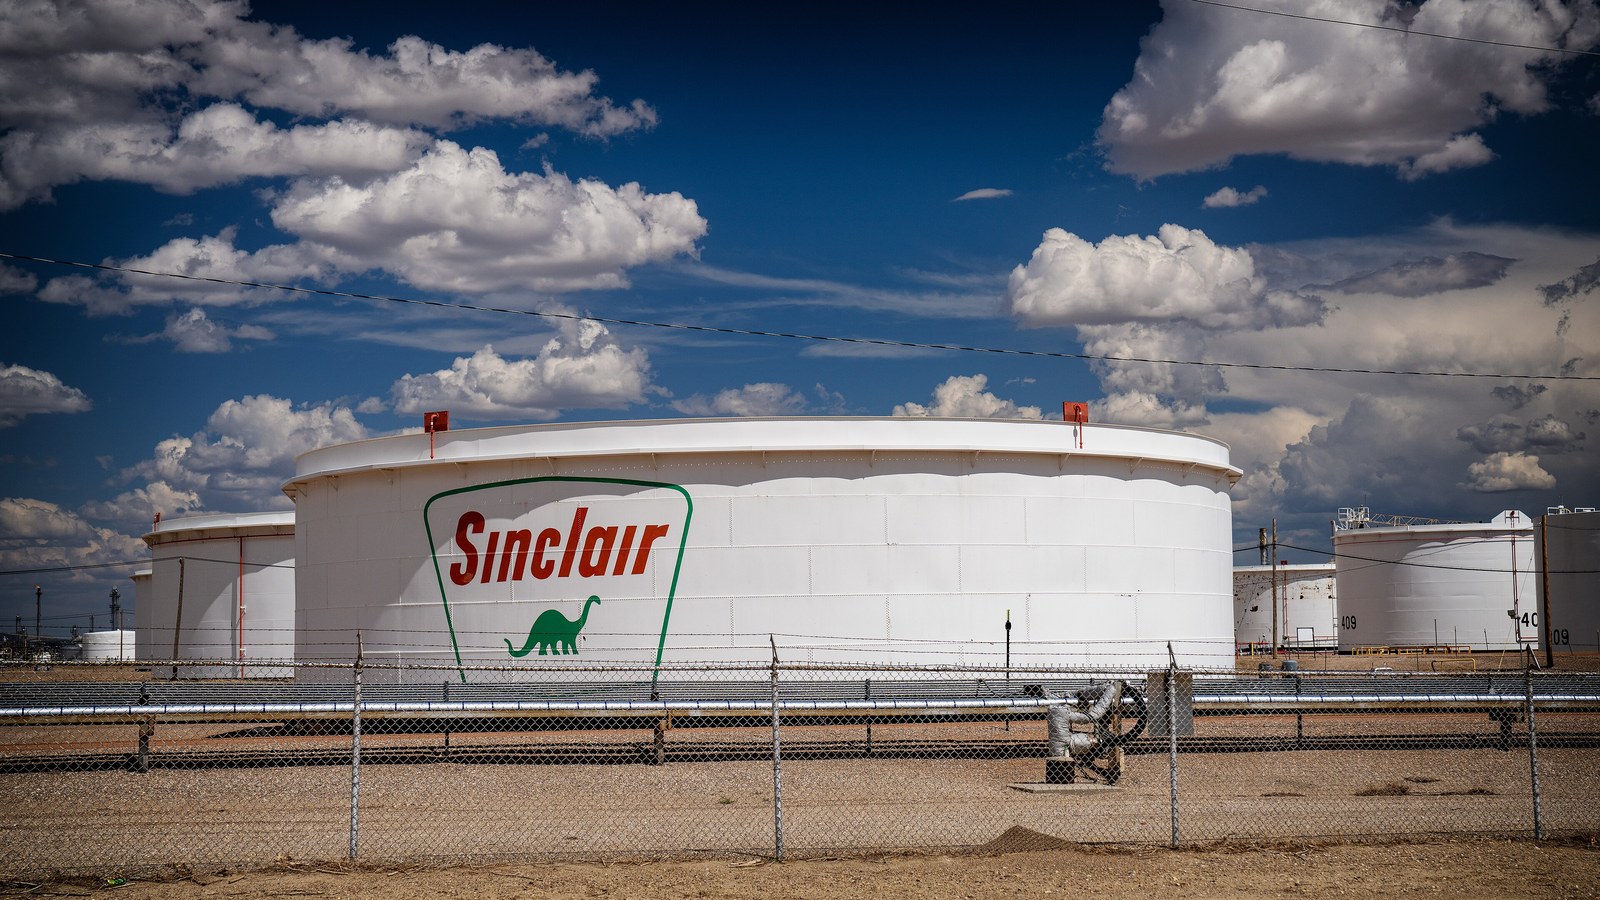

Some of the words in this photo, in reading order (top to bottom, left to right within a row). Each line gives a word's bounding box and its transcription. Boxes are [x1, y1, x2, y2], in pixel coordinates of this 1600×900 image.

[450, 507, 669, 585] Sinclair
[1341, 615, 1357, 630] 409
[1521, 612, 1538, 627] 40
[1553, 628, 1570, 645] 09
